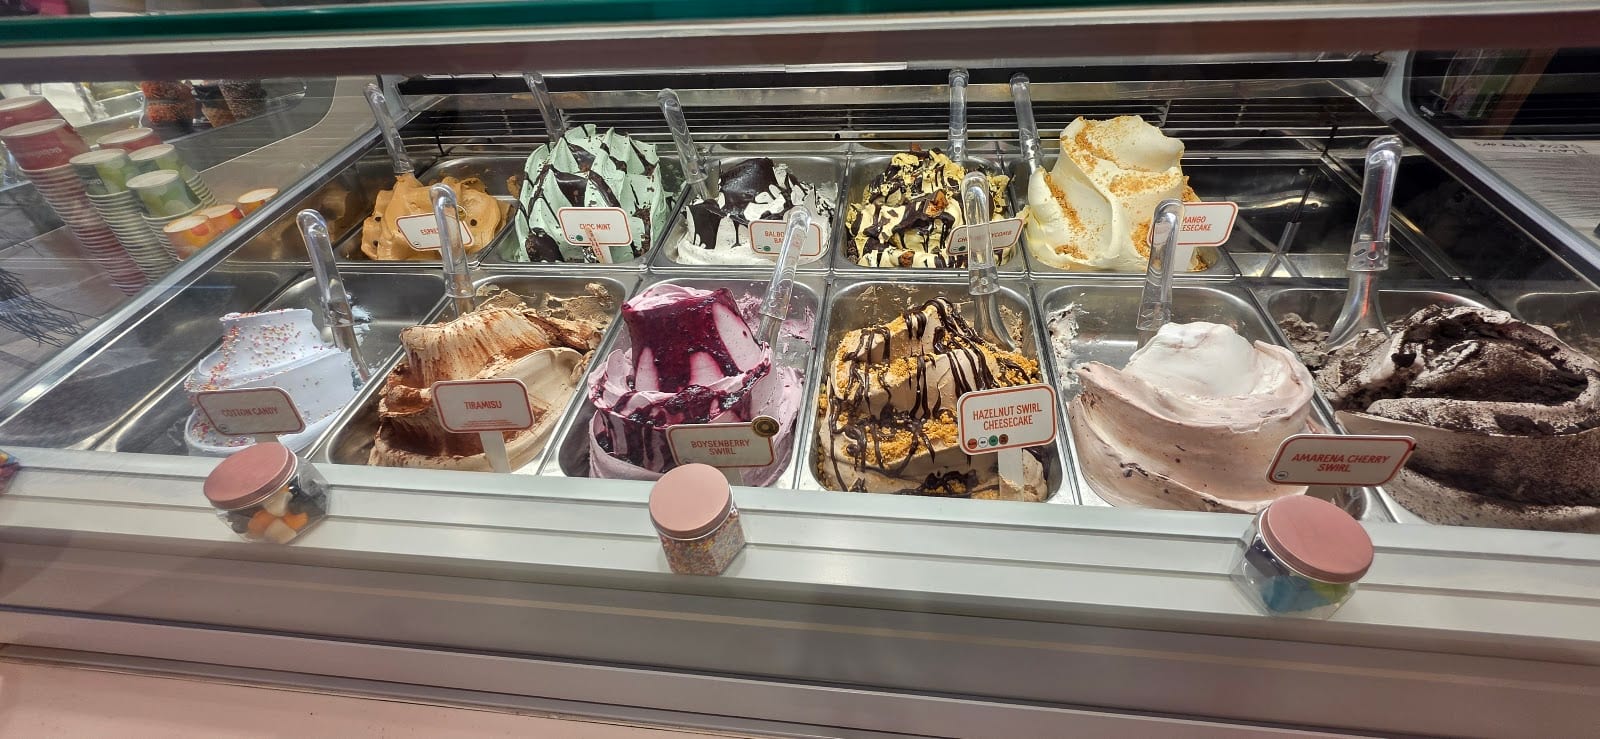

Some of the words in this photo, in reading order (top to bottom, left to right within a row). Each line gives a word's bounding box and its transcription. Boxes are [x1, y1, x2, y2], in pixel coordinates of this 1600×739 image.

[464, 400, 502, 410] TIRAMISU
[222, 407, 252, 417] COTTON
[253, 406, 278, 416] CANDY
[973, 406, 1014, 421] HAZELNUT
[1016, 402, 1042, 415] SWIRL
[984, 415, 1034, 430] CHEESECAKE
[690, 440, 750, 448] BOYSENBERRY
[708, 448, 736, 456] SWIRL
[1291, 454, 1345, 462] AMARENA
[1347, 455, 1391, 464] CHERRY
[1316, 463, 1351, 472] SWIRL
